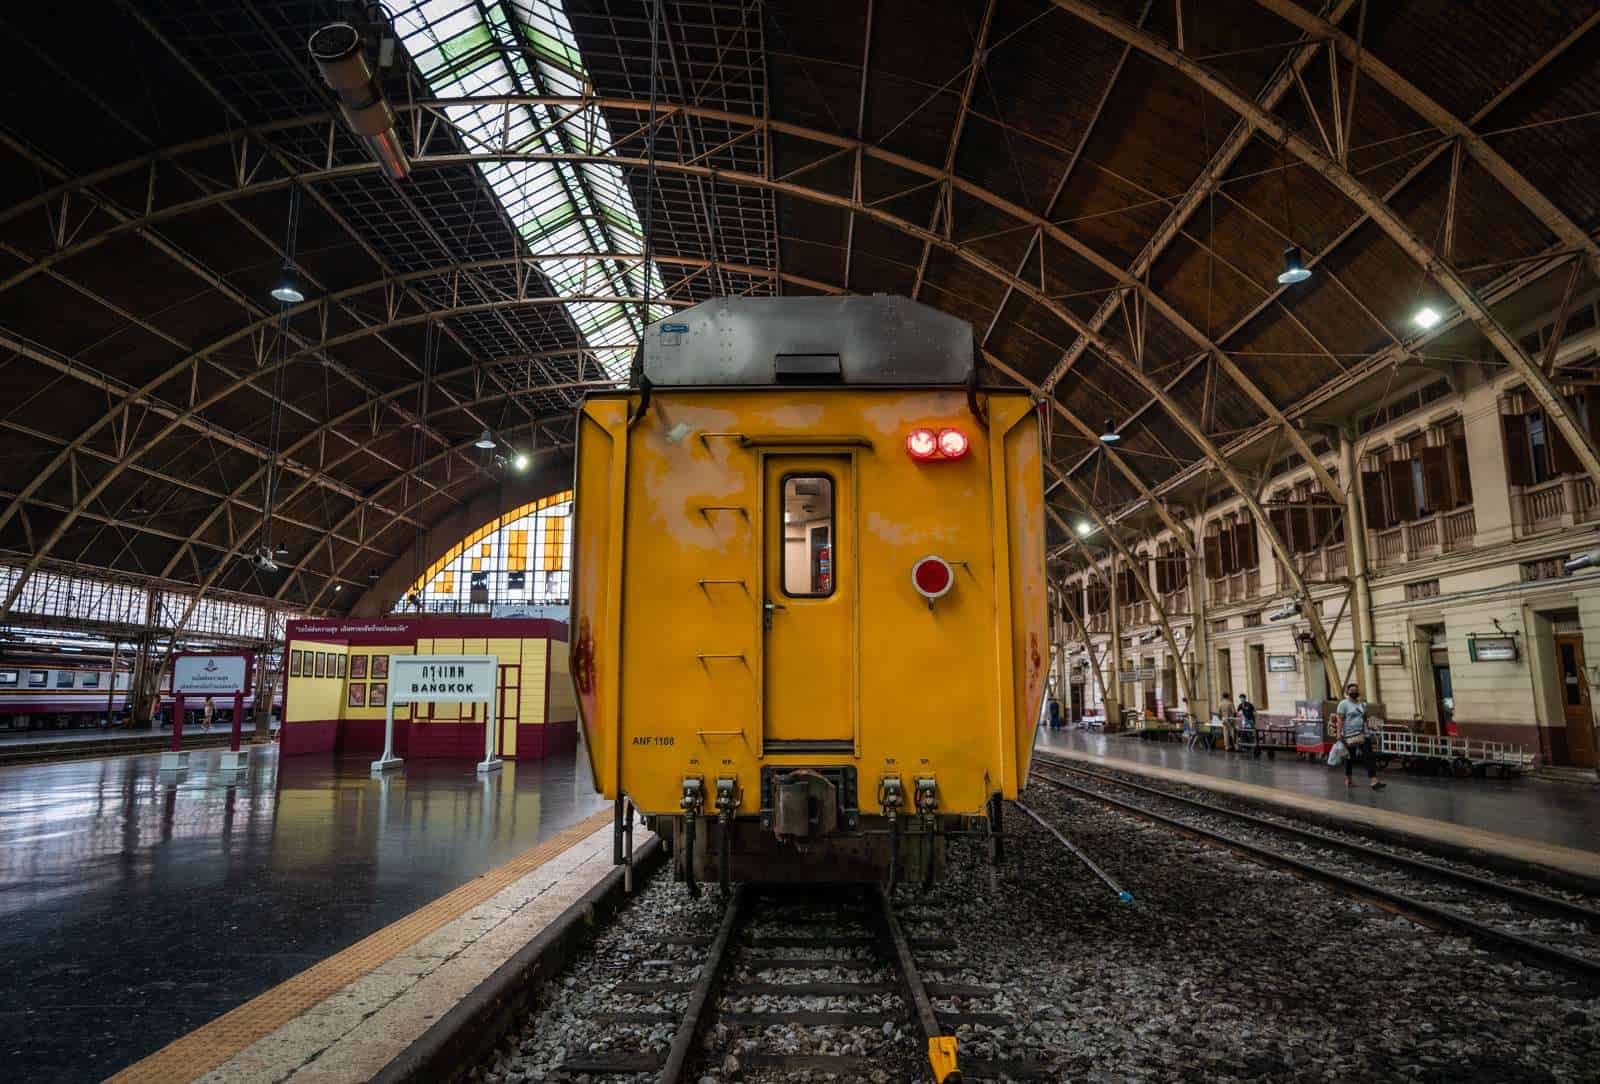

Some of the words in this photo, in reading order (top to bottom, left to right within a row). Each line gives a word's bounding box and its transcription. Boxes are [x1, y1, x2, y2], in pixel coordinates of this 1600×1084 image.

[422, 666, 465, 683] กรุงเทพ
[411, 683, 474, 693] BANGKOK
[632, 736, 652, 745] ANF
